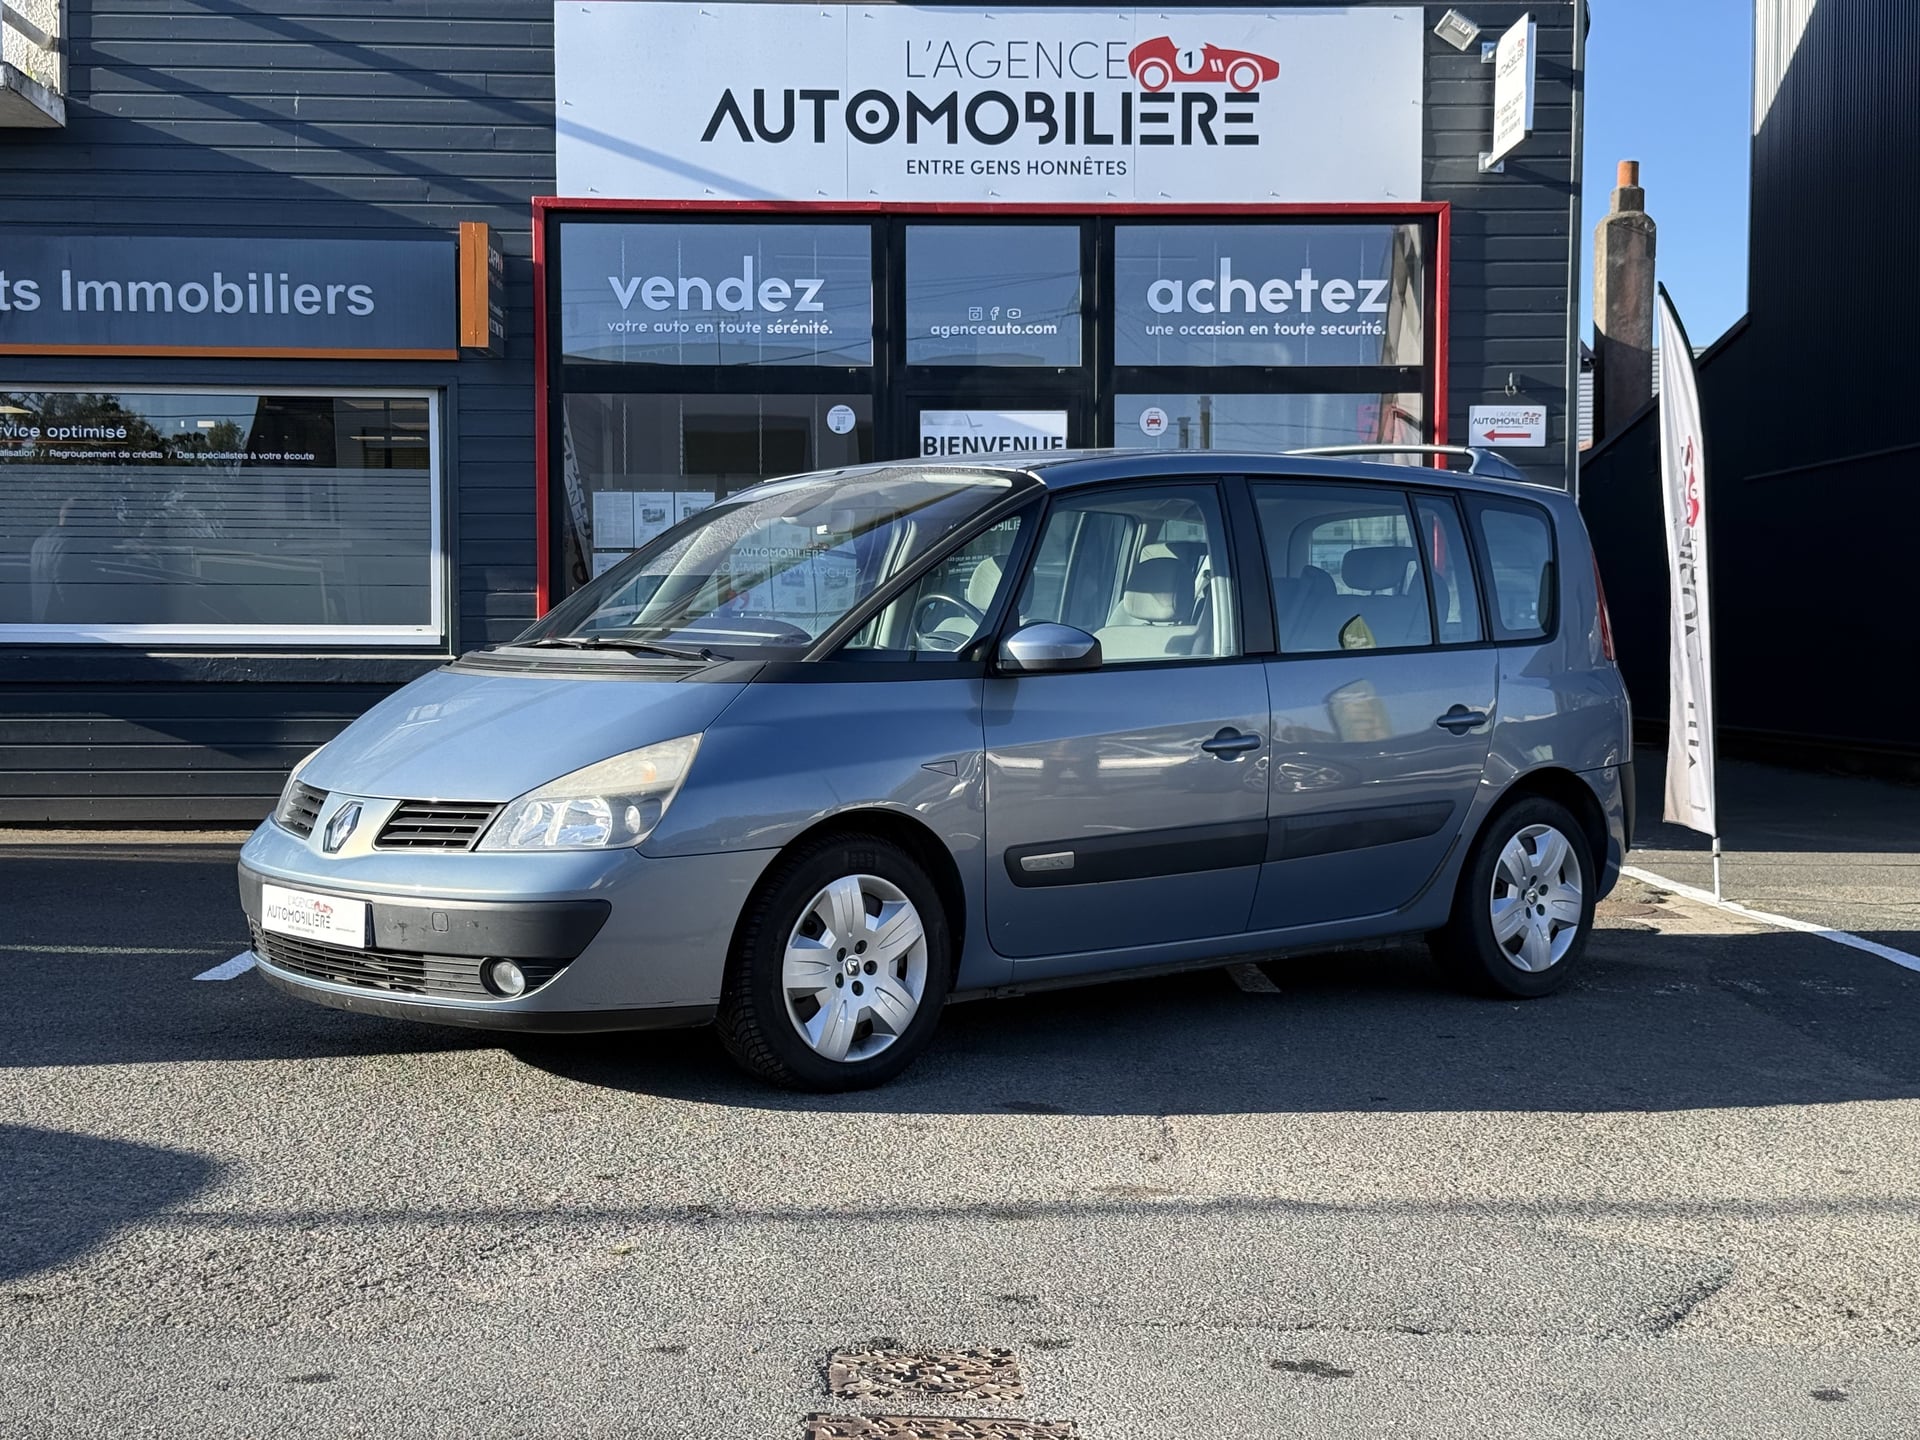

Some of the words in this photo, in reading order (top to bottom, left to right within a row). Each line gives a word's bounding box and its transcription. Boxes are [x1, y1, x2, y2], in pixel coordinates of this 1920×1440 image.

[906, 39, 1127, 80] L'AGENCE
[906, 159, 965, 175] ENTRE
[970, 159, 1021, 175] GENS
[1026, 156, 1127, 176] HONNÊTES
[61, 269, 375, 316] Immobiliers
[608, 256, 825, 312] vendez
[1146, 257, 1389, 314] achetez
[608, 321, 648, 333] votre
[653, 321, 690, 333] auto
[695, 322, 714, 333] en
[719, 321, 761, 334] toute
[766, 319, 833, 335] sérénité.
[930, 322, 1057, 337] agenceauto.com
[1146, 324, 1174, 336] une
[1179, 321, 1244, 336] occasion
[1249, 325, 1269, 336] en
[1274, 322, 1315, 336] toute
[1320, 320, 1386, 336] securité.
[47, 425, 127, 440] optimisé
[50, 450, 116, 459] Regroupement
[119, 450, 130, 458] de
[133, 450, 163, 458] crédits
[177, 451, 195, 459] Des
[197, 451, 248, 460] spécialistes
[251, 451, 256, 459] à
[259, 452, 281, 460] votre
[284, 452, 314, 460] écoute
